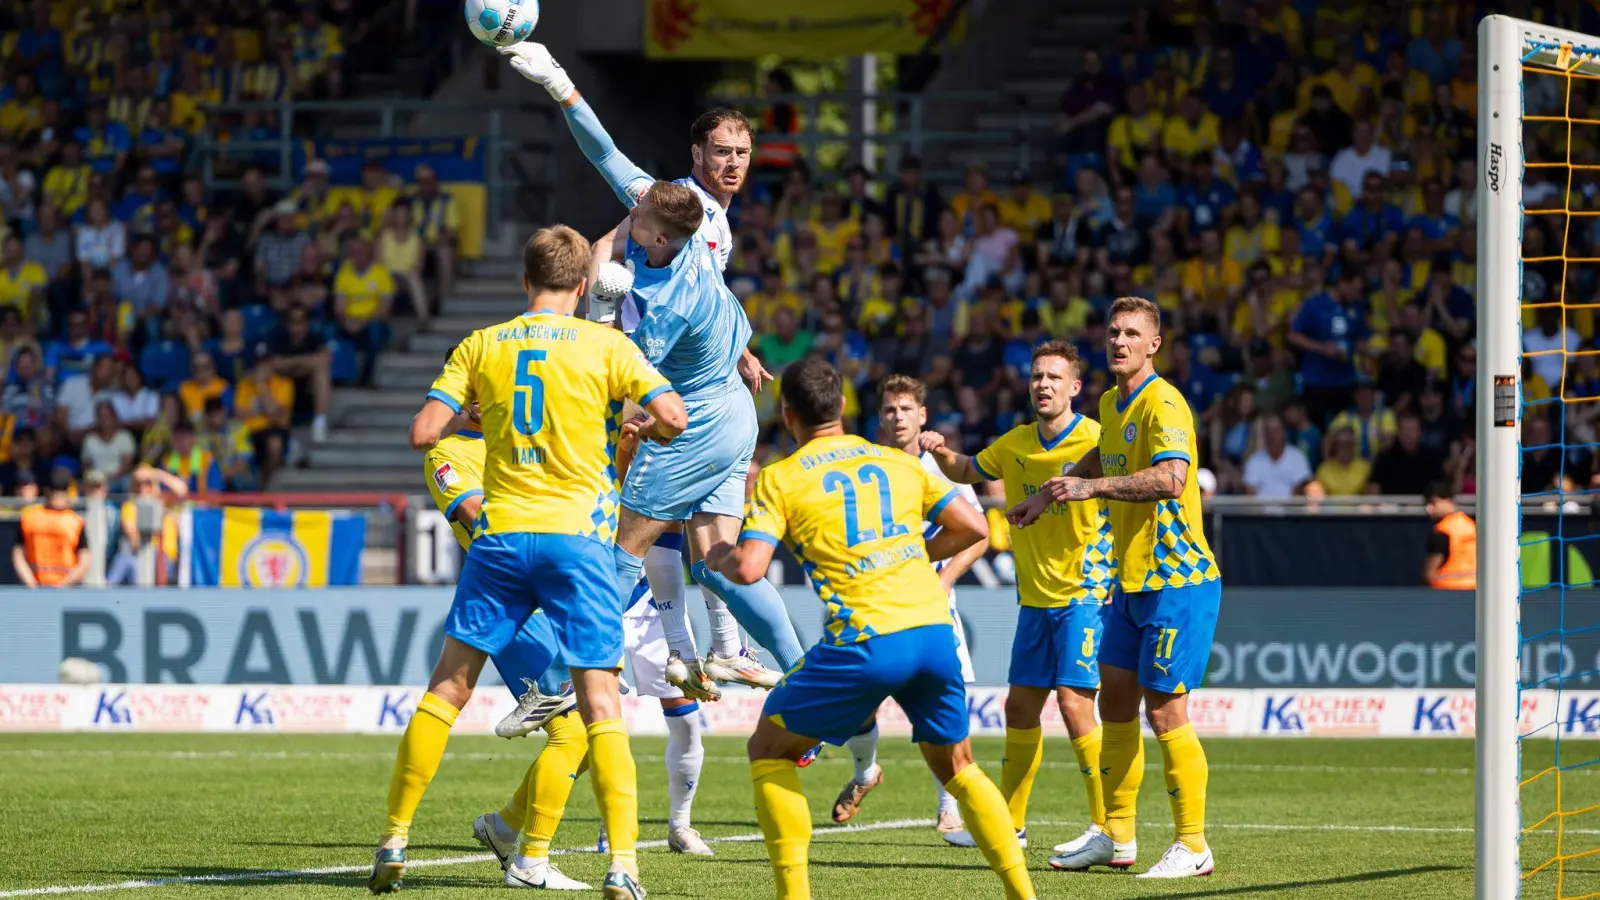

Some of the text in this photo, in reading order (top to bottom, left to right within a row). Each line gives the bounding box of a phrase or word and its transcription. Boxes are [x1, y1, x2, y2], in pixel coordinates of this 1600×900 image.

[1488, 142, 1502, 192] Haspo
[497, 324, 578, 342] BRAUNSCHWEIG
[513, 349, 547, 435] 5
[1100, 453, 1127, 468] RAWO
[822, 464, 909, 548] 22
[657, 601, 674, 612] KSC
[61, 608, 450, 685] BRAW
[1081, 628, 1096, 658] 3
[1155, 628, 1179, 660] 17
